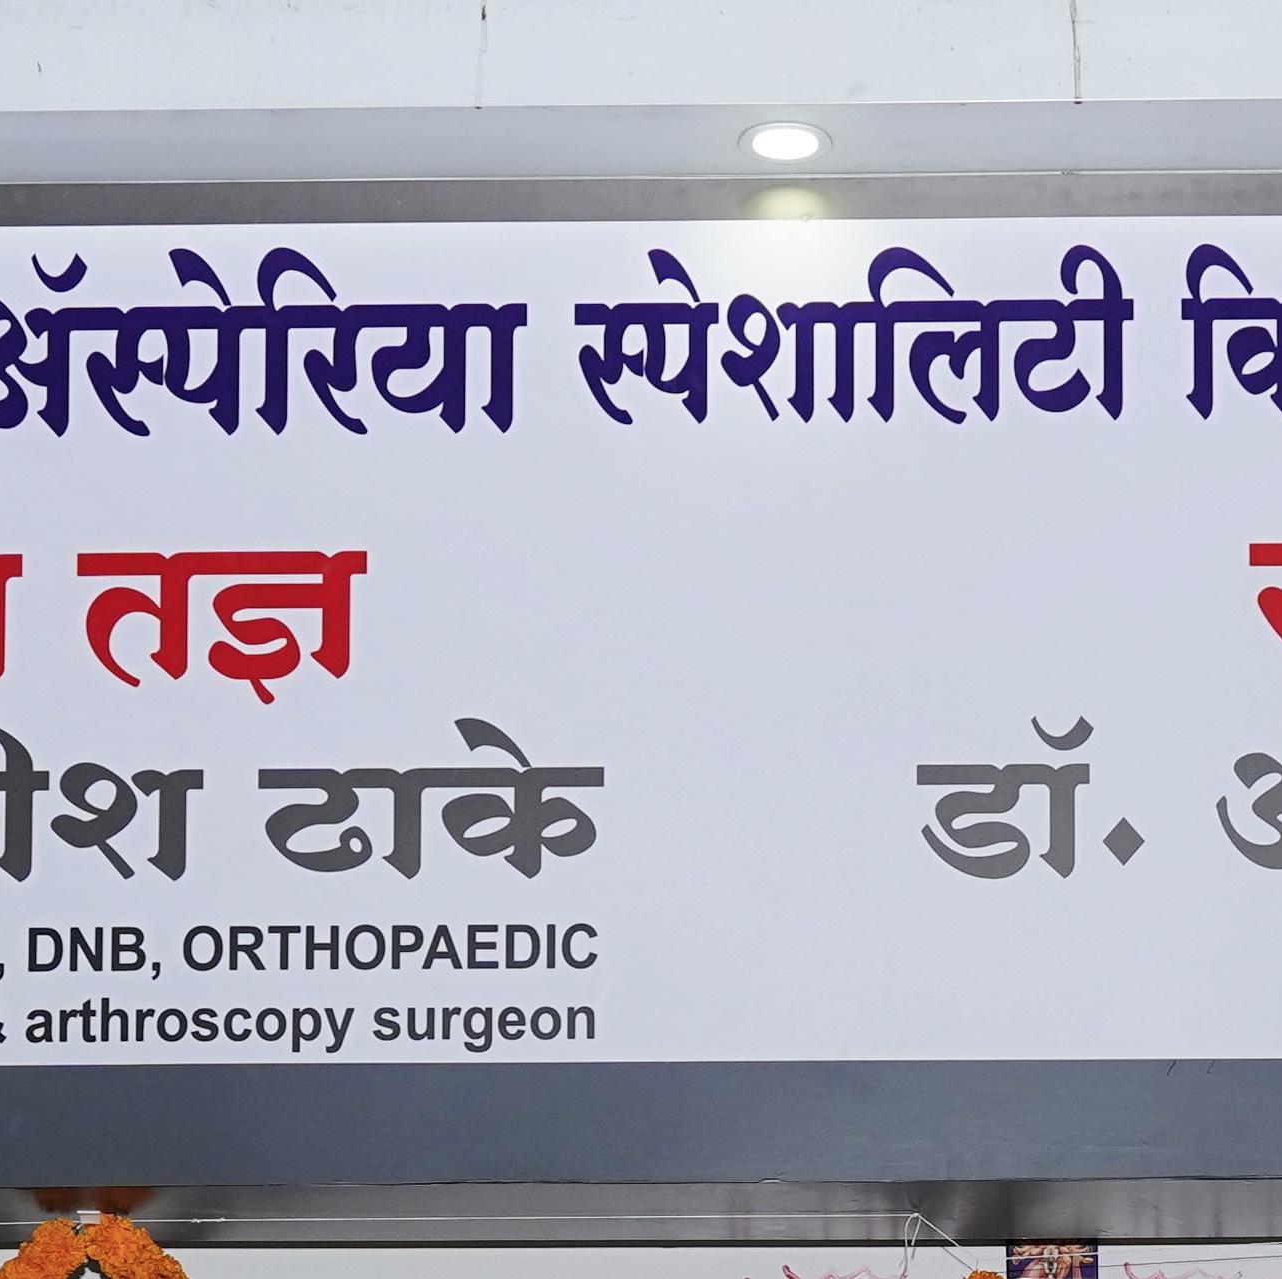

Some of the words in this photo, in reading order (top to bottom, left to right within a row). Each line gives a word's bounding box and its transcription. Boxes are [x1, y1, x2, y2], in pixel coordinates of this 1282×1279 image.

[574, 245, 1134, 425] स्पेशालिटी
[77, 551, 367, 704] तज्ञ
[258, 718, 604, 879] ढाके
[917, 716, 1144, 879] डॉ.
[26, 997, 355, 1053] arthroscopy
[373, 1006, 595, 1053] surgeon
[28, 927, 160, 980] DNB,
[183, 923, 598, 971] ORTHOPAEDIC
